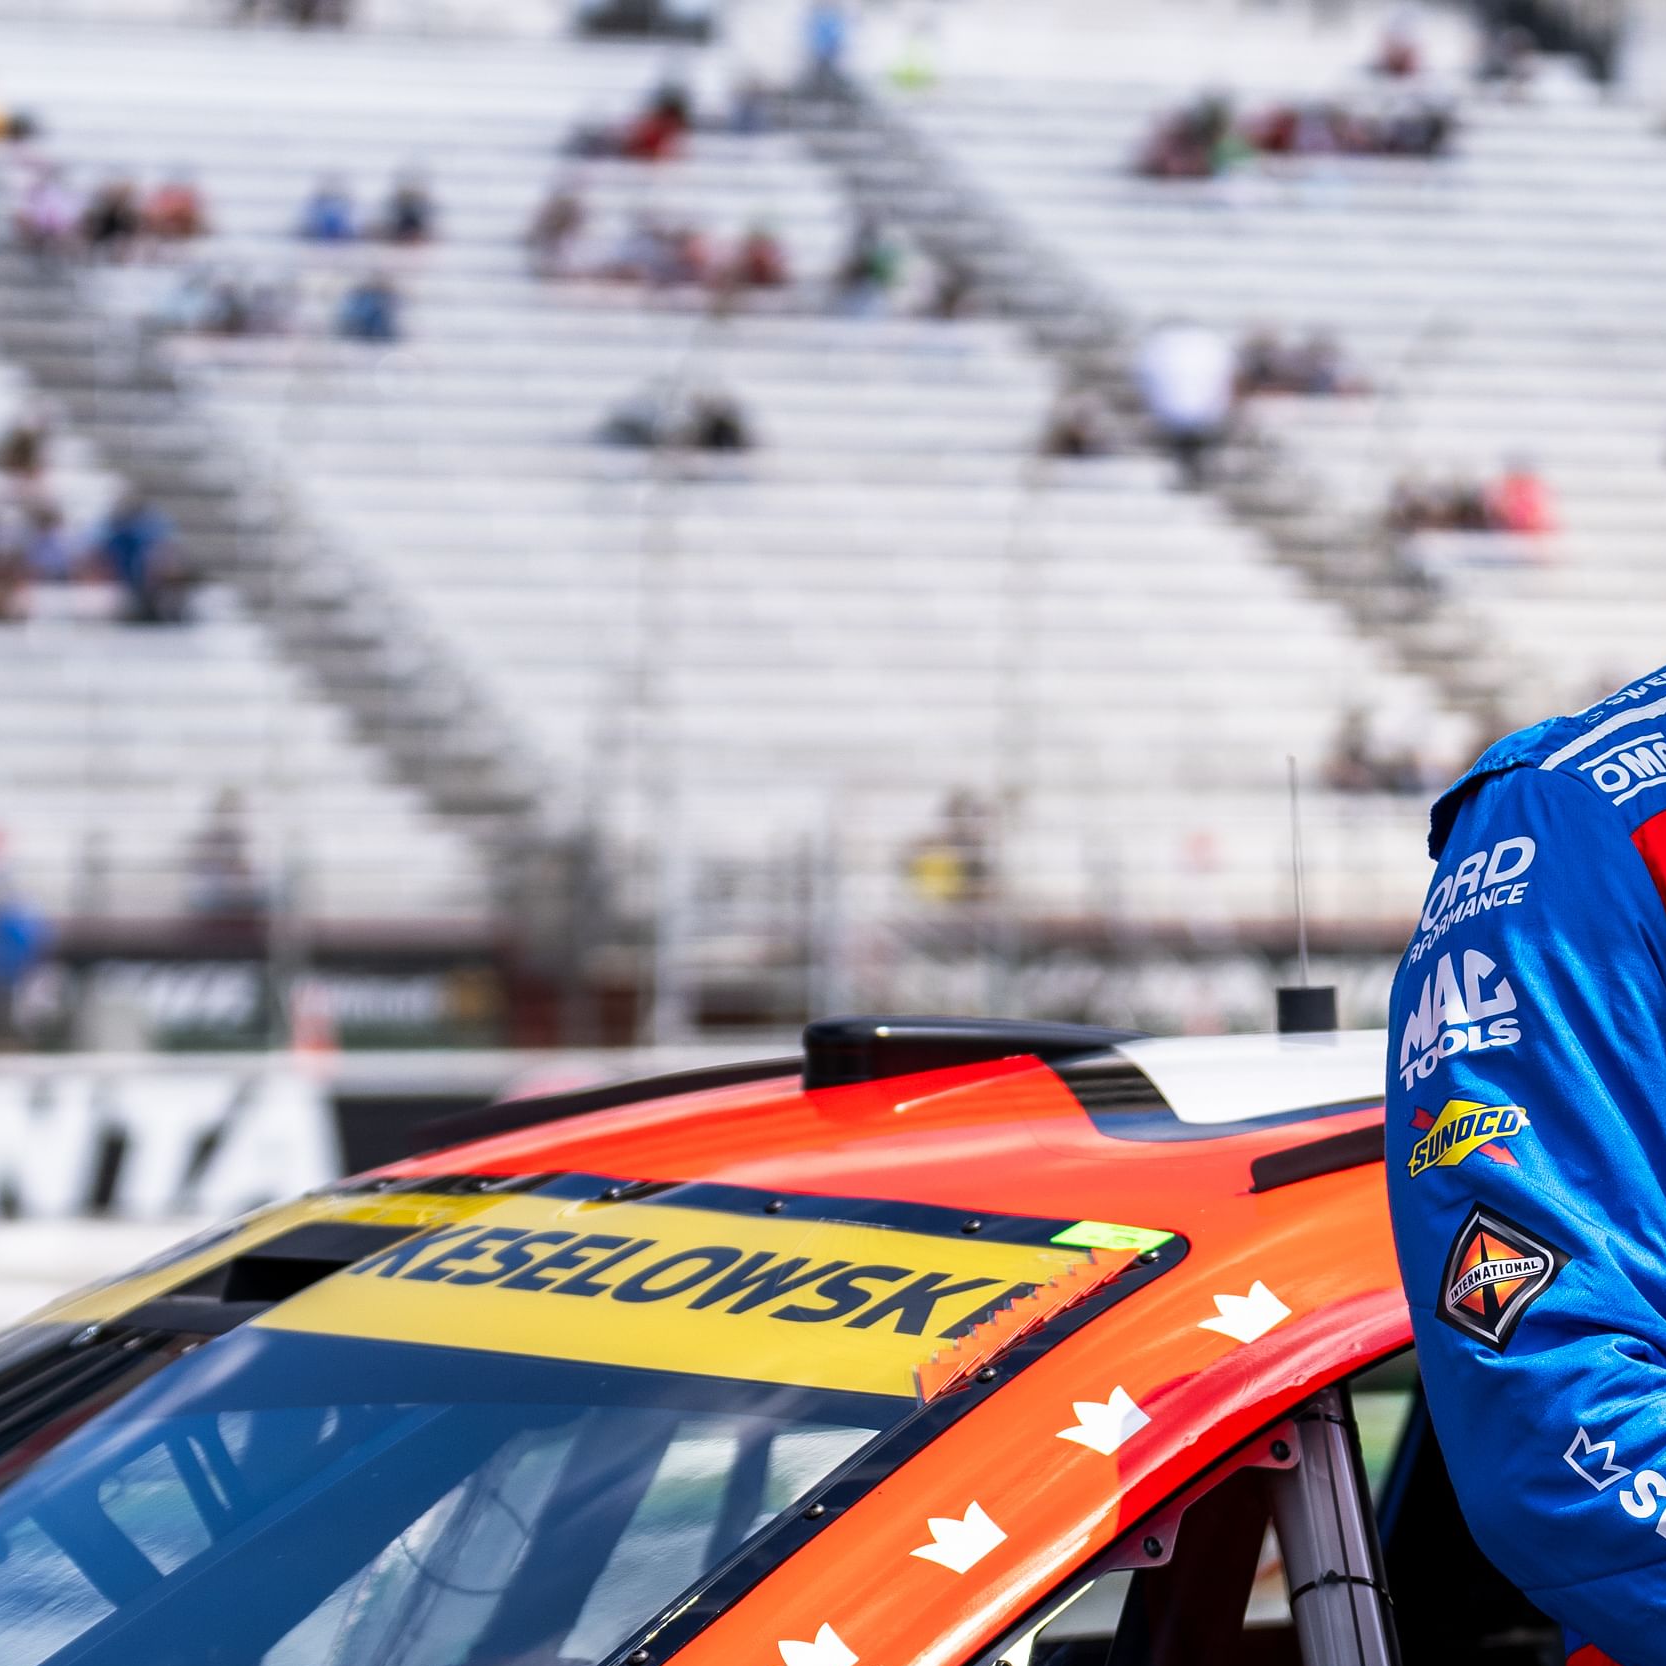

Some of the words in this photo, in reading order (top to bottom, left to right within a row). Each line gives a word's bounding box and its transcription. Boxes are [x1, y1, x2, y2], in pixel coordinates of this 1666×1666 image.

[1407, 881, 1529, 970] RFORMANCE
[1420, 836, 1536, 933] ORD
[1399, 949, 1518, 1070] MAC
[1399, 1017, 1522, 1092] TOOLS
[1413, 1110, 1520, 1170] SUNOCO
[349, 1222, 1042, 1341] KESELOWSKI
[1450, 1259, 1540, 1301] INTERNATIONAL
